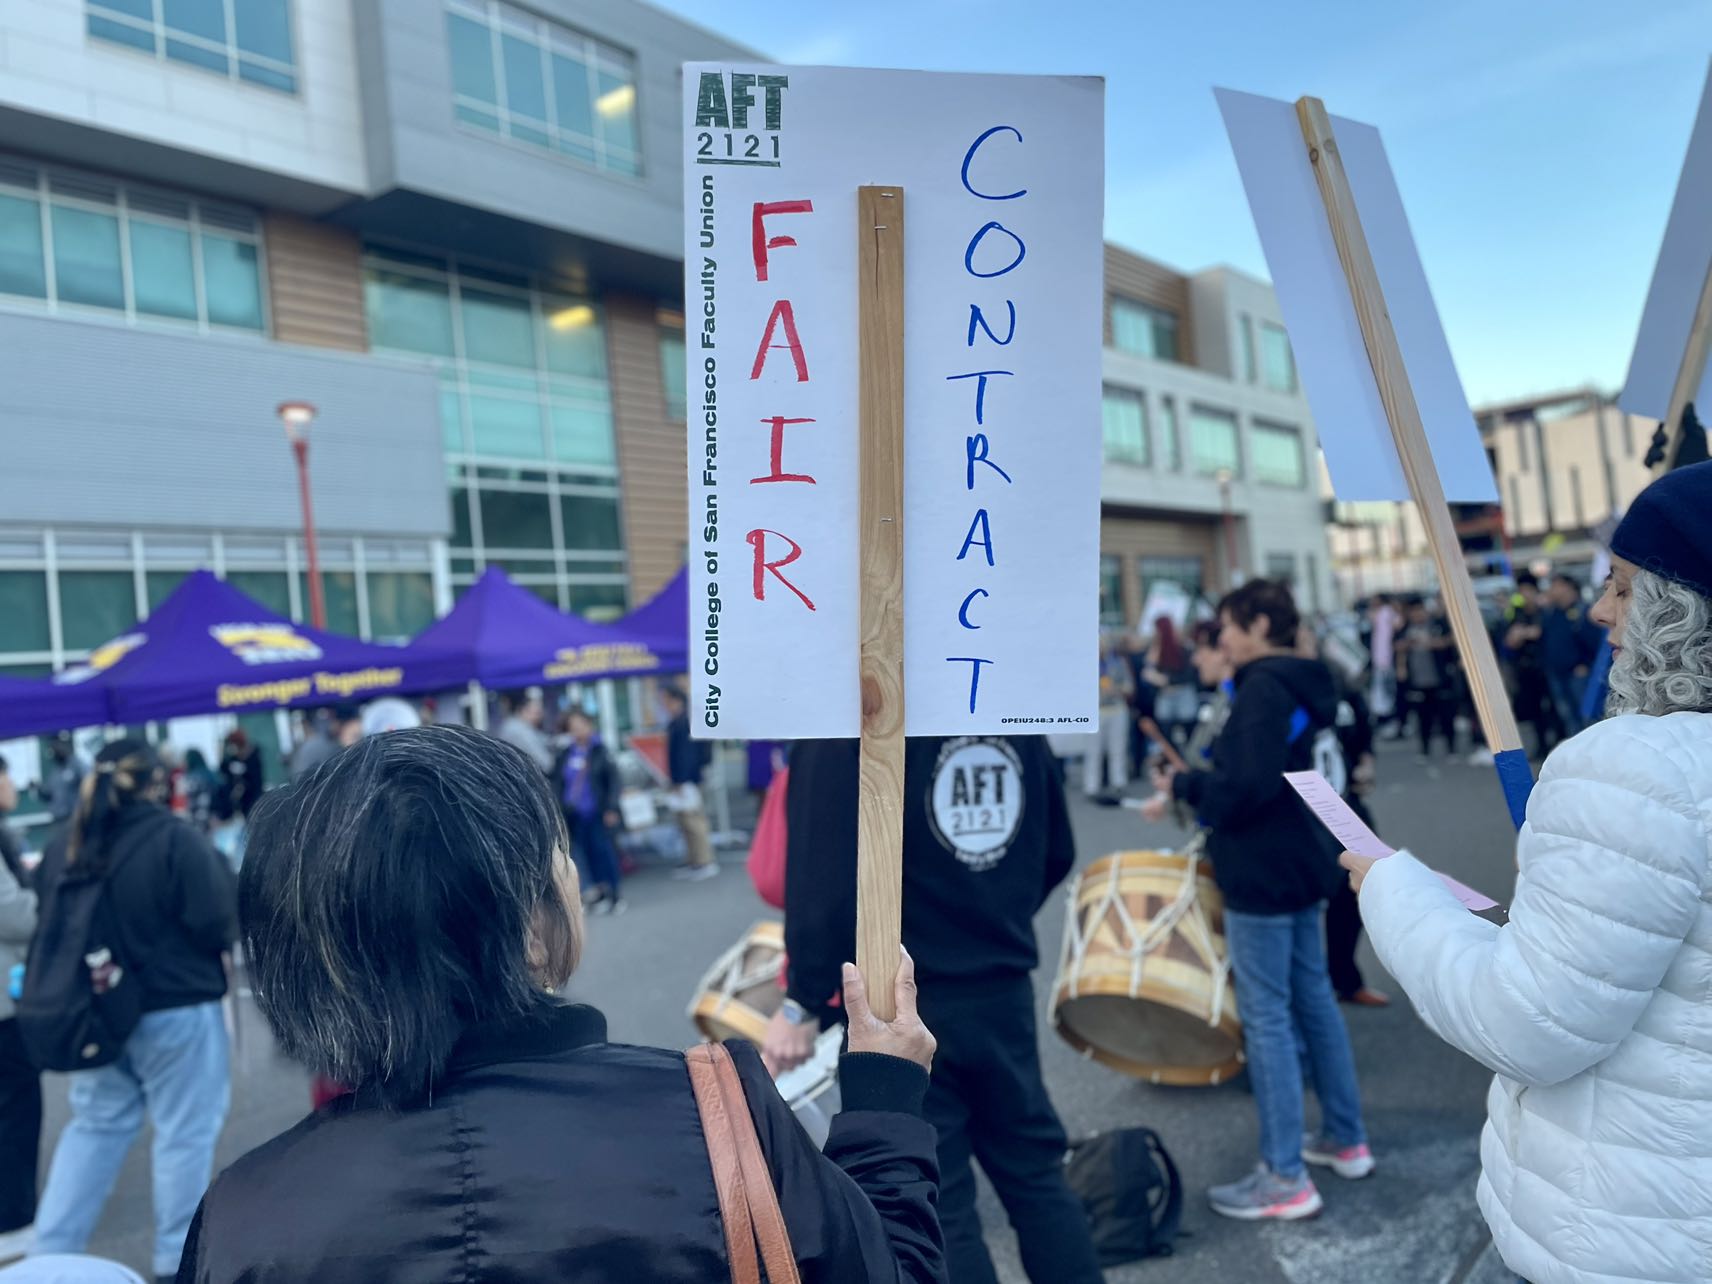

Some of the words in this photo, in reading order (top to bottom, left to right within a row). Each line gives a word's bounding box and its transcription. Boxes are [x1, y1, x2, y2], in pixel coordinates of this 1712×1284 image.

[695, 71, 789, 131] AFT
[697, 132, 780, 159] 2121
[699, 175, 715, 248] Union
[700, 256, 717, 349] Faculty
[702, 357, 718, 486] Francisco
[746, 200, 817, 611] FAIR
[946, 125, 1027, 715] CONTRACT
[703, 494, 718, 543] San
[704, 550, 718, 575] of
[704, 582, 722, 676] College
[313, 667, 404, 696] Together
[704, 683, 722, 728] City
[951, 765, 1007, 807] AFT
[952, 808, 1006, 830] 2121
